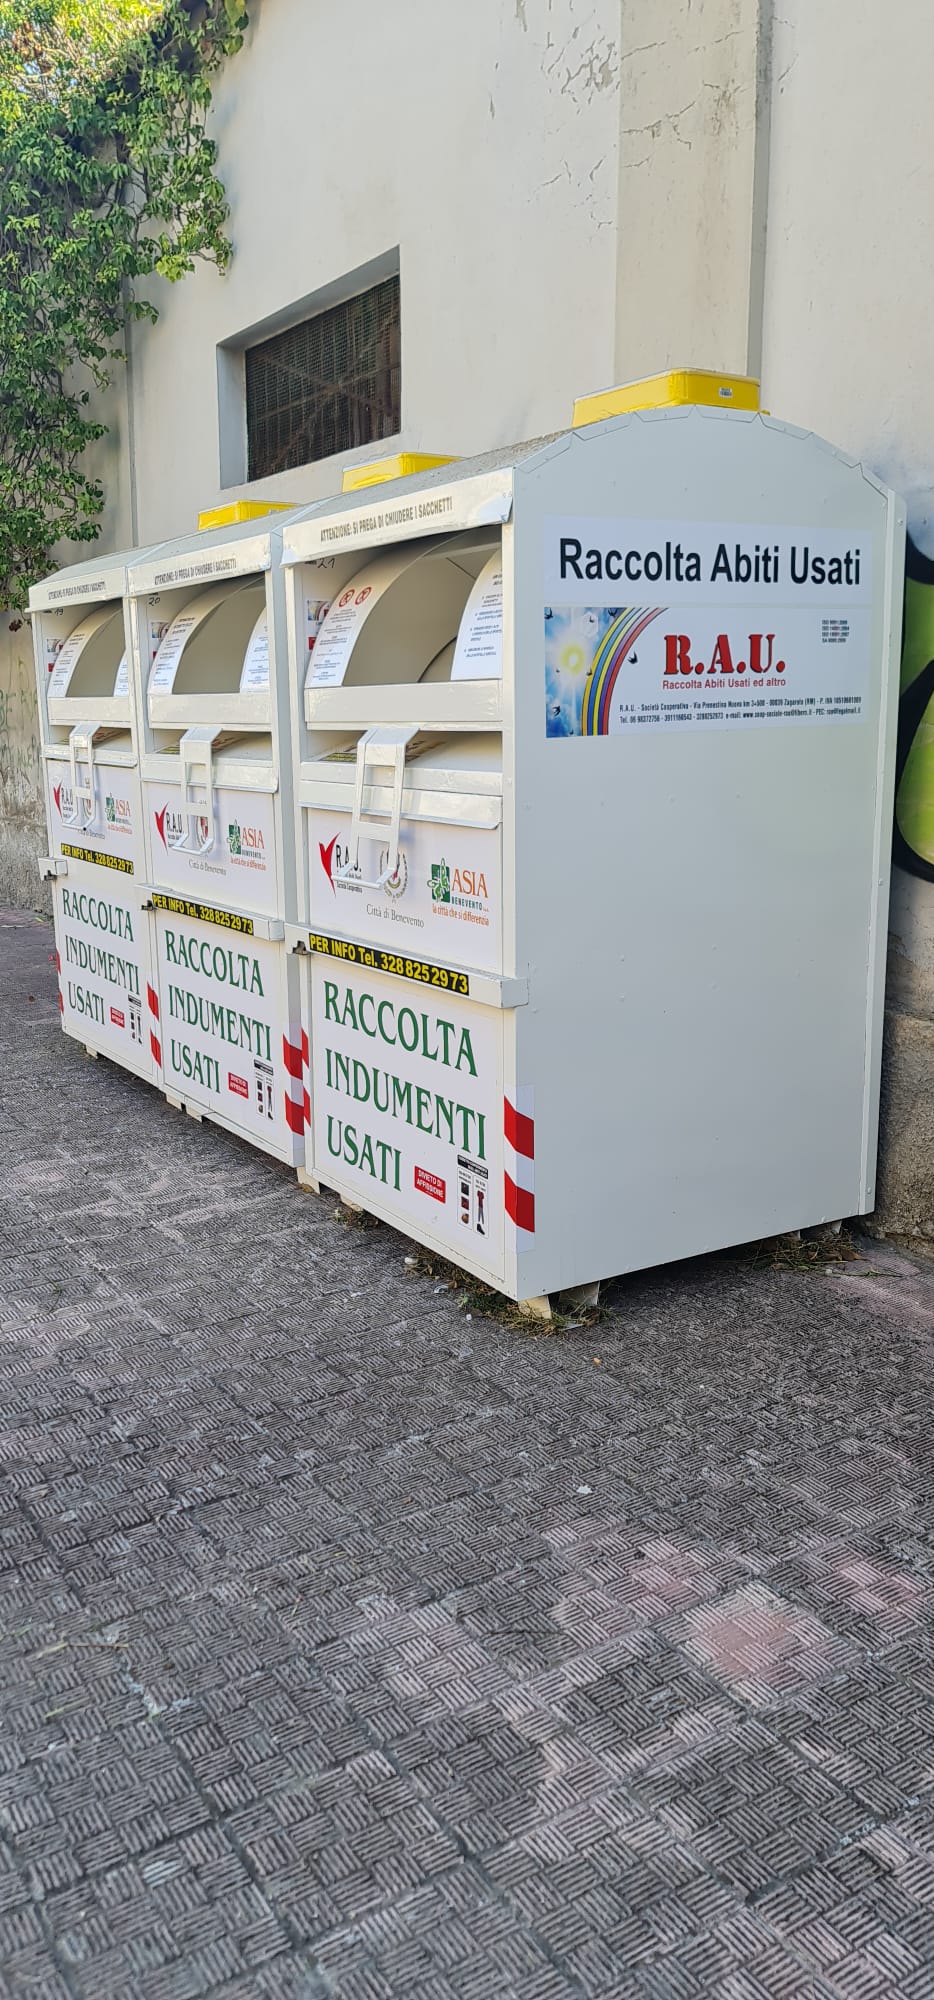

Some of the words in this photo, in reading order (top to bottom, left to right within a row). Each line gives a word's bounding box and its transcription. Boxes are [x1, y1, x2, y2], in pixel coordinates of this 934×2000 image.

[320, 522, 352, 541] ATTENZIONE:
[353, 521, 359, 534] SI
[360, 517, 377, 532] PREGA
[378, 515, 384, 528] DI
[385, 506, 413, 526] CHIUDERE
[418, 496, 452, 519] SACCHETTI
[559, 537, 701, 581] Raccolta
[710, 543, 779, 583] Abiti
[790, 545, 860, 585] Usati
[148, 597, 160, 606] 20
[663, 633, 786, 675] R.A.U.
[662, 679, 702, 690] Raccolta
[704, 678, 725, 689] Abiti
[728, 677, 750, 688] Usati
[753, 677, 764, 687] ed
[766, 677, 786, 687] altro
[619, 704, 636, 712] R.A.U.
[641, 703, 659, 712] Società
[660, 702, 689, 711] Cooperativa
[693, 701, 701, 710] Via
[702, 700, 727, 709] Prenestina
[804, 697, 816, 706] (RM)
[620, 716, 629, 724] Tel.
[61, 787, 74, 805] R.A.U
[61, 844, 71, 856] PER
[71, 846, 83, 860] INFO
[84, 849, 95, 862] Tel.
[241, 827, 265, 849] ASIA
[335, 843, 362, 872] R.A.
[451, 868, 489, 898] ASIA
[62, 887, 134, 943] RACCOLTA
[152, 894, 168, 909] PER
[168, 897, 185, 913] INFO
[185, 902, 199, 918] Tel.
[200, 906, 214, 922] 328
[215, 910, 230, 927] 825
[366, 903, 381, 917] Città
[383, 907, 390, 919] di
[391, 909, 425, 928] Benevento
[432, 903, 437, 914] la
[437, 905, 449, 917] città
[449, 908, 458, 918] che
[463, 911, 489, 927] differenzia
[451, 896, 483, 910] BENEVENTO
[65, 934, 141, 996] INDUMENTI
[164, 929, 264, 998] RACCOLTA
[309, 934, 329, 953] PER
[331, 940, 356, 961] INFO
[358, 947, 379, 967] Tel.
[381, 953, 404, 975] 328
[405, 960, 431, 983] 825
[68, 980, 105, 1026] USATI
[168, 984, 272, 1061] INDUMENTI
[323, 980, 478, 1078] RACCOLTA
[171, 1038, 220, 1094] USATI
[325, 1047, 486, 1161] INDUMENTI
[326, 1114, 402, 1192] USATI
[417, 1178, 444, 1198] AFFISSIONE
[418, 1169, 437, 1185] DIVIETO
[436, 1179, 443, 1188] DI
